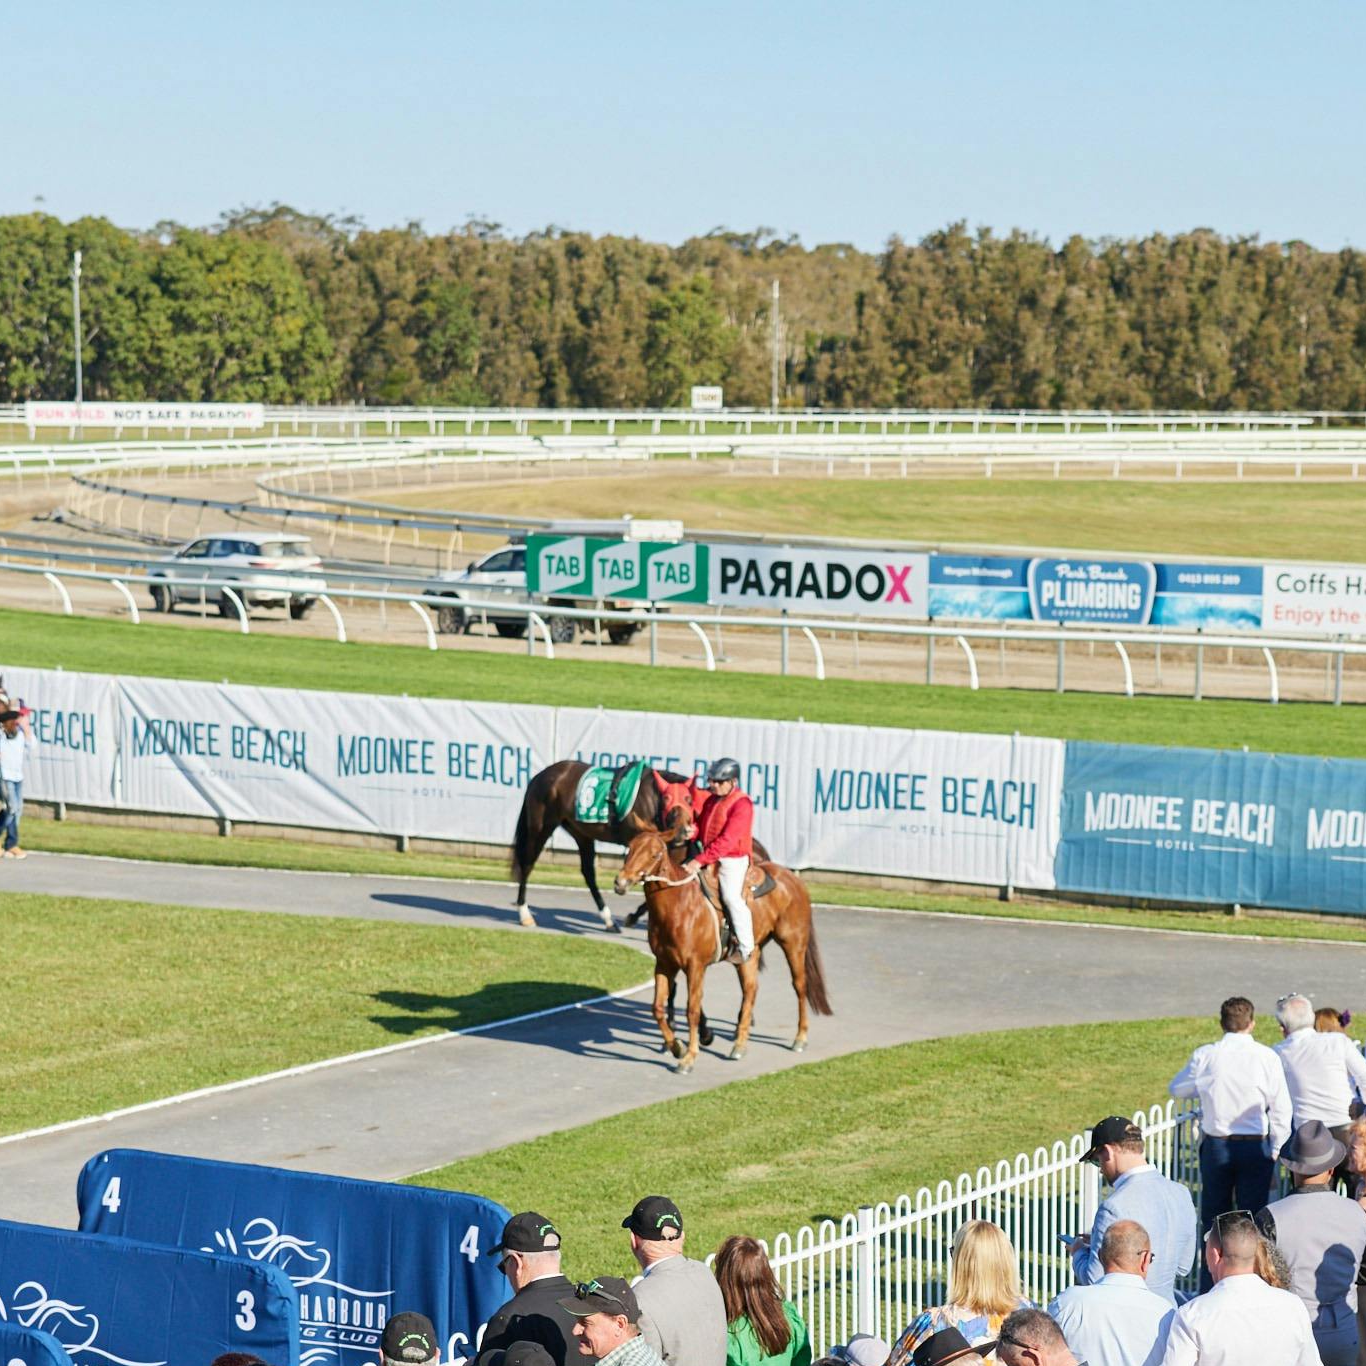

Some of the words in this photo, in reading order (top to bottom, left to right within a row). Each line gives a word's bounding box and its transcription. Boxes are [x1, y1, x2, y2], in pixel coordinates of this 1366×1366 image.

[114, 411, 142, 420] NOT
[544, 555, 580, 577] TAB
[598, 558, 634, 580] TAB
[653, 562, 690, 584] TAB
[1041, 580, 1142, 610] PLUMBING
[1276, 572, 1337, 595] Coffs
[1274, 604, 1325, 628] Enjoy
[1330, 606, 1360, 624] the
[132, 716, 221, 758] MOONEE
[232, 725, 307, 773] BEACH
[337, 735, 435, 777] MOONEE
[448, 742, 531, 789] BEACH
[412, 787, 453, 799] HOTEL
[695, 759, 779, 810] BCH
[814, 767, 927, 815] MOONEE
[942, 777, 1035, 830] BEACH
[900, 824, 947, 837] HOTEL
[1084, 791, 1181, 832] MOONEE
[1191, 799, 1275, 847] BEACH
[1156, 839, 1196, 853] HOTEL
[102, 1176, 121, 1213] 4
[459, 1225, 480, 1264] 4
[235, 1289, 255, 1332] 3
[300, 1294, 386, 1330] HARBOUR
[324, 1329, 378, 1345] CLUB
